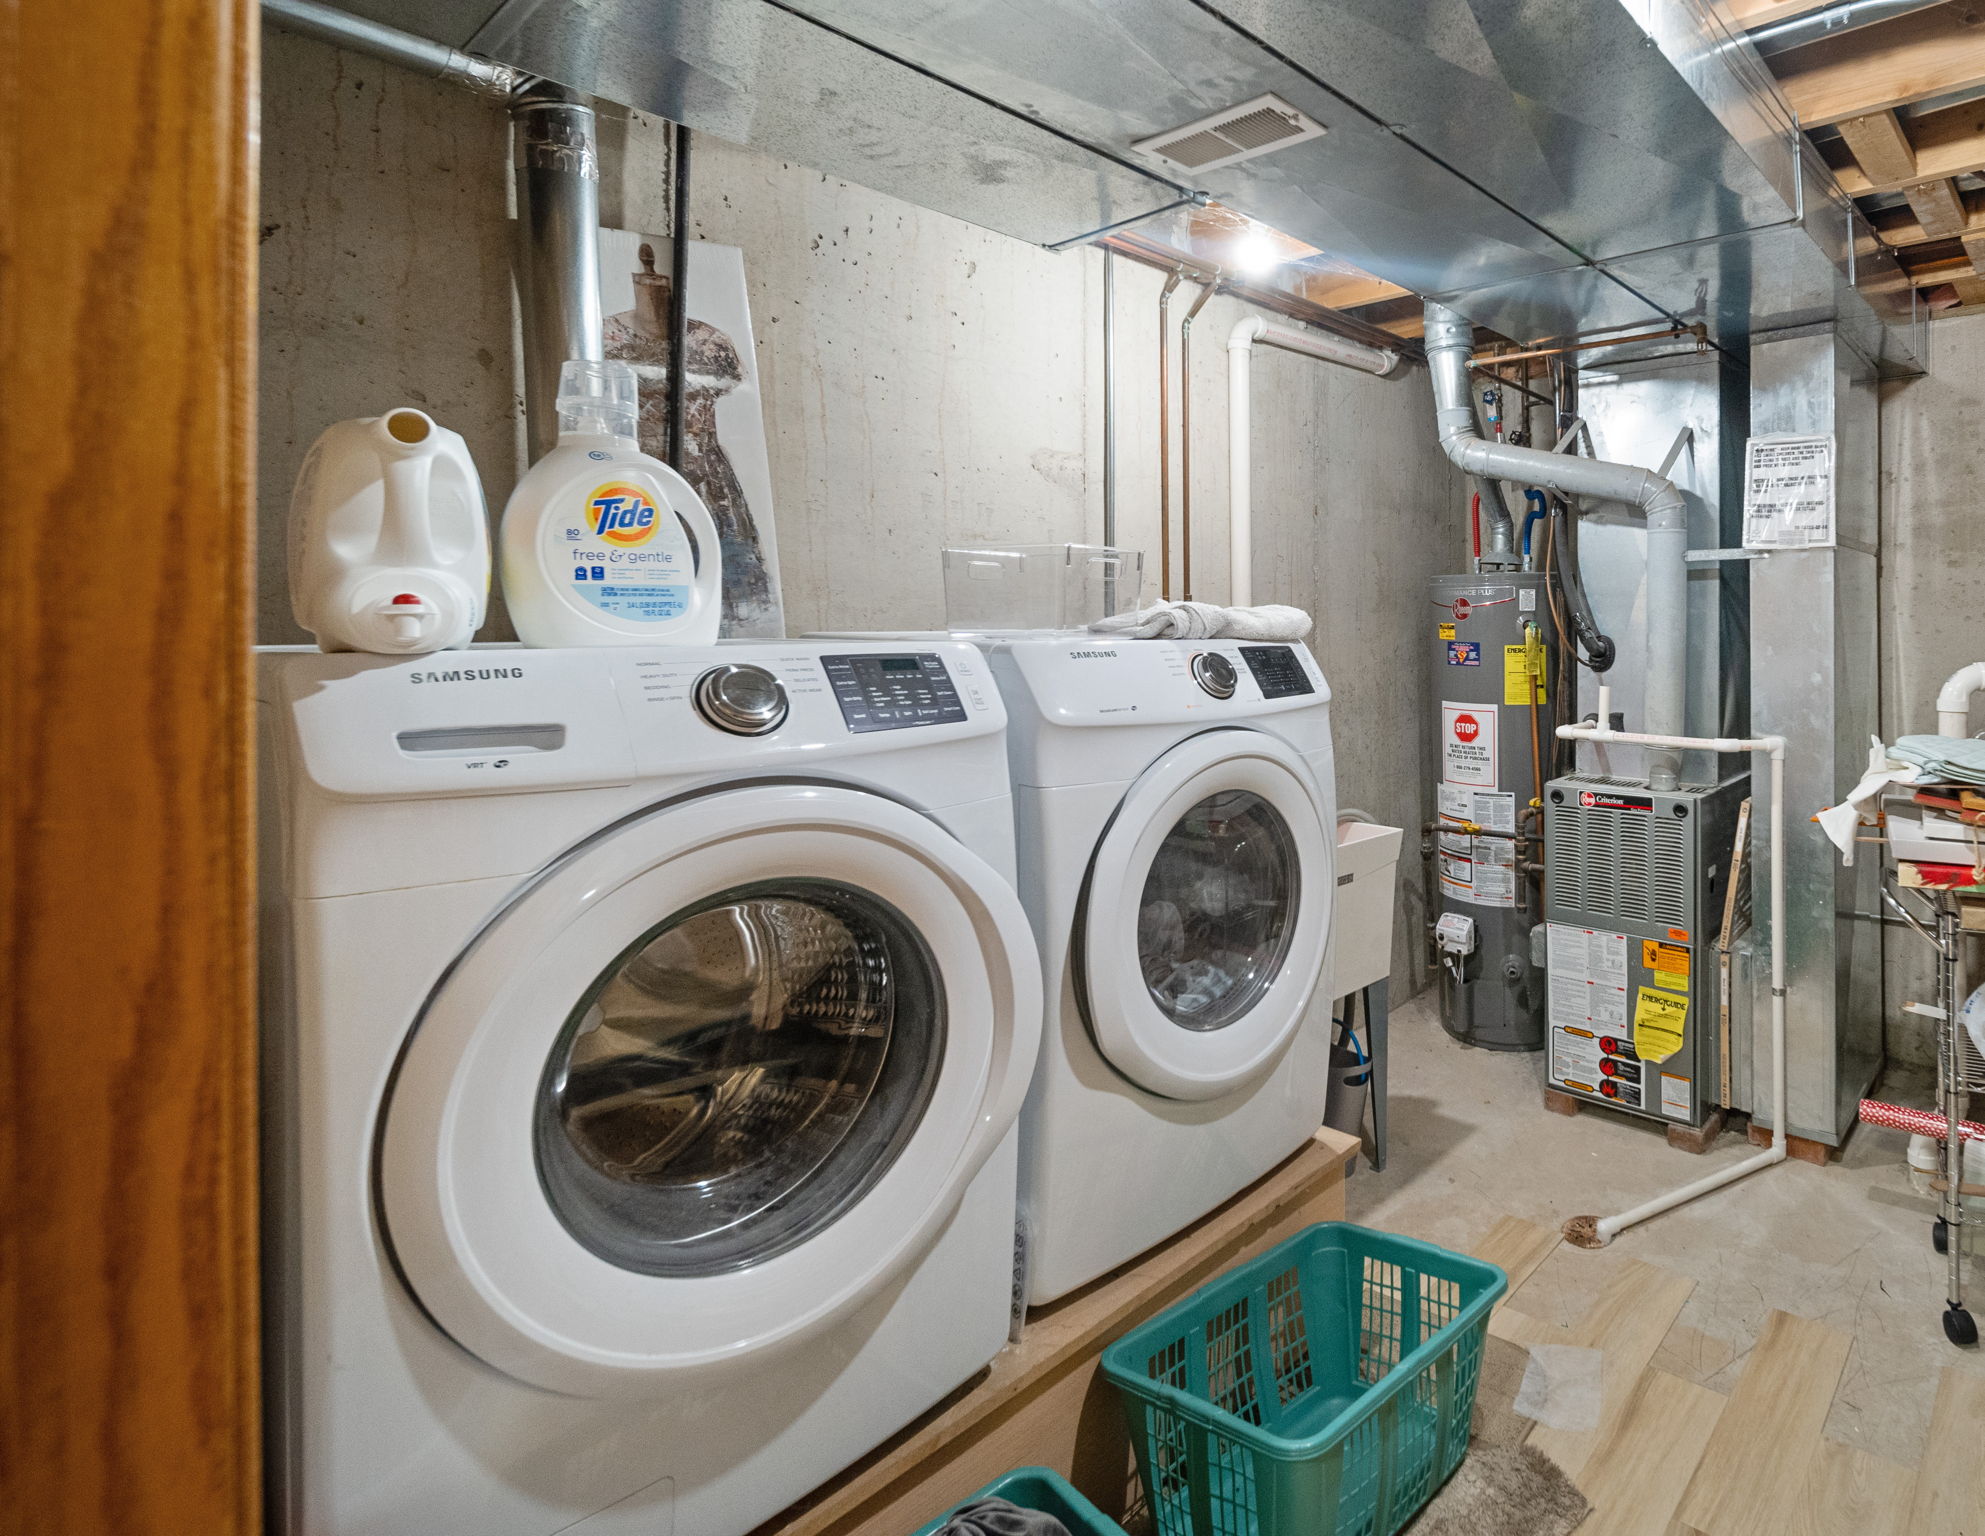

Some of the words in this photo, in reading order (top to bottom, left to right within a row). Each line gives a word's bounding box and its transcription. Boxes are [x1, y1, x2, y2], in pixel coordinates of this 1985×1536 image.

[593, 498, 654, 535] Tide
[572, 549, 606, 560] free
[609, 550, 626, 562] &
[627, 551, 673, 563] gentle
[1070, 650, 1118, 660] SAMSUNG
[410, 667, 524, 685] SAMSUNG
[1456, 722, 1477, 734] STOP
[1596, 796, 1624, 805] Criterion
